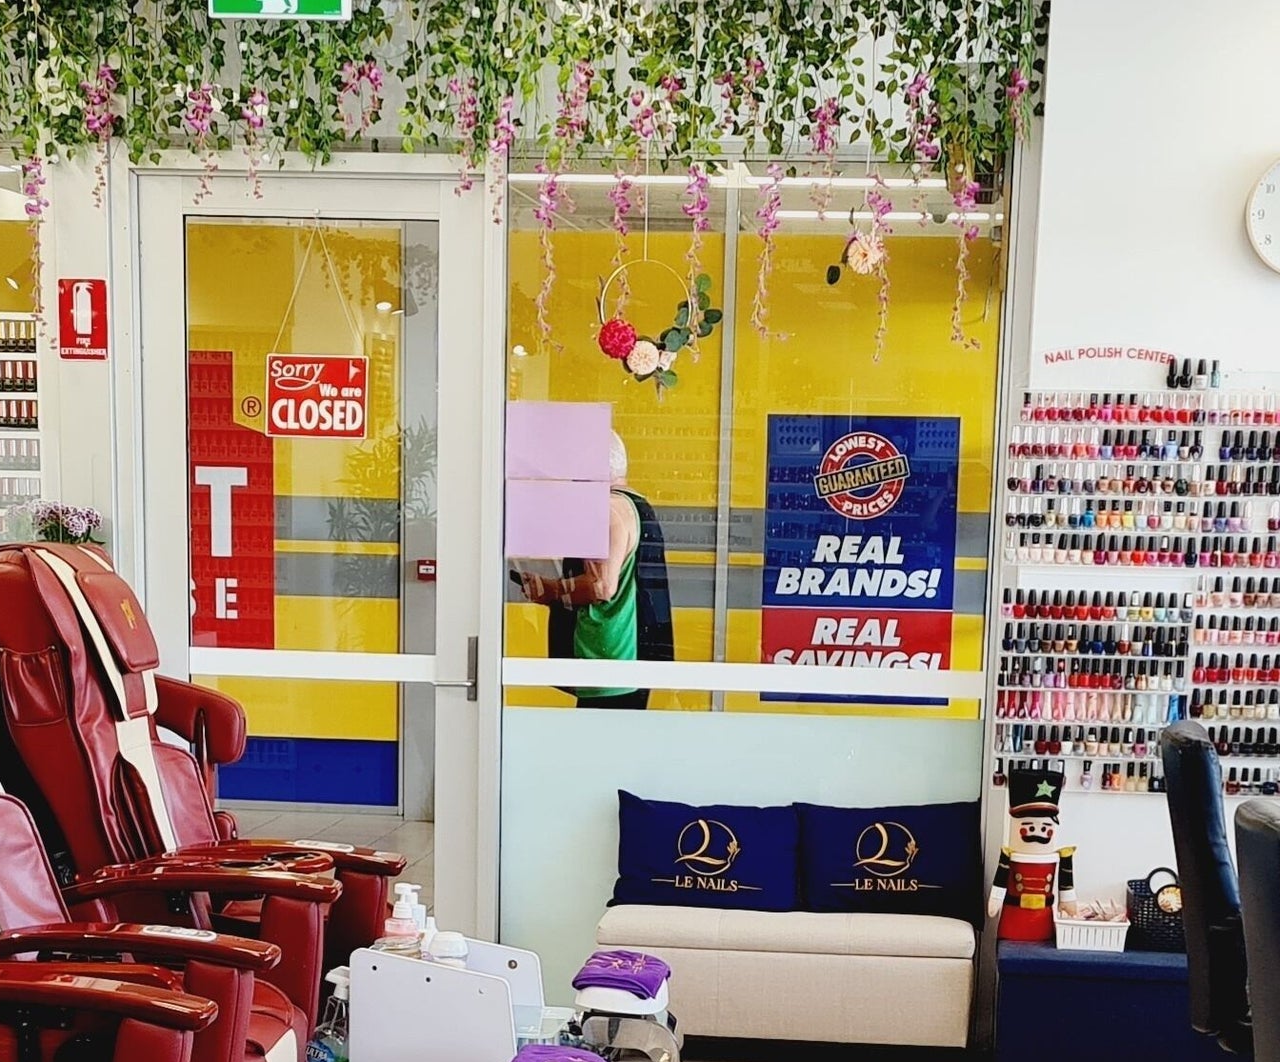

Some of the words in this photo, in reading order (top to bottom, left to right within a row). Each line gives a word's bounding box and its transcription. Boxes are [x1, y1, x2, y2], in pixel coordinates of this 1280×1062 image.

[1265, 182, 1276, 194] 10
[1257, 209, 1265, 220] 9
[1264, 234, 1272, 246] 8
[1044, 350, 1074, 365] NAIL
[1078, 347, 1122, 359] POLISH
[1126, 347, 1175, 364] CENTER
[271, 360, 325, 391] Sorry
[319, 383, 338, 397] We
[341, 387, 362, 397] are
[272, 398, 363, 431] CLOSED
[828, 436, 885, 462] LOWEST
[818, 458, 906, 494] GUARANTEED
[842, 490, 894, 515] PRICES
[812, 535, 904, 564] REAL
[775, 567, 942, 598] BRANDS!
[811, 617, 901, 647] REAL
[675, 875, 693, 889] LE
[697, 876, 738, 892] NAILS
[855, 878, 873, 891] LE
[877, 879, 918, 892] NAILS
